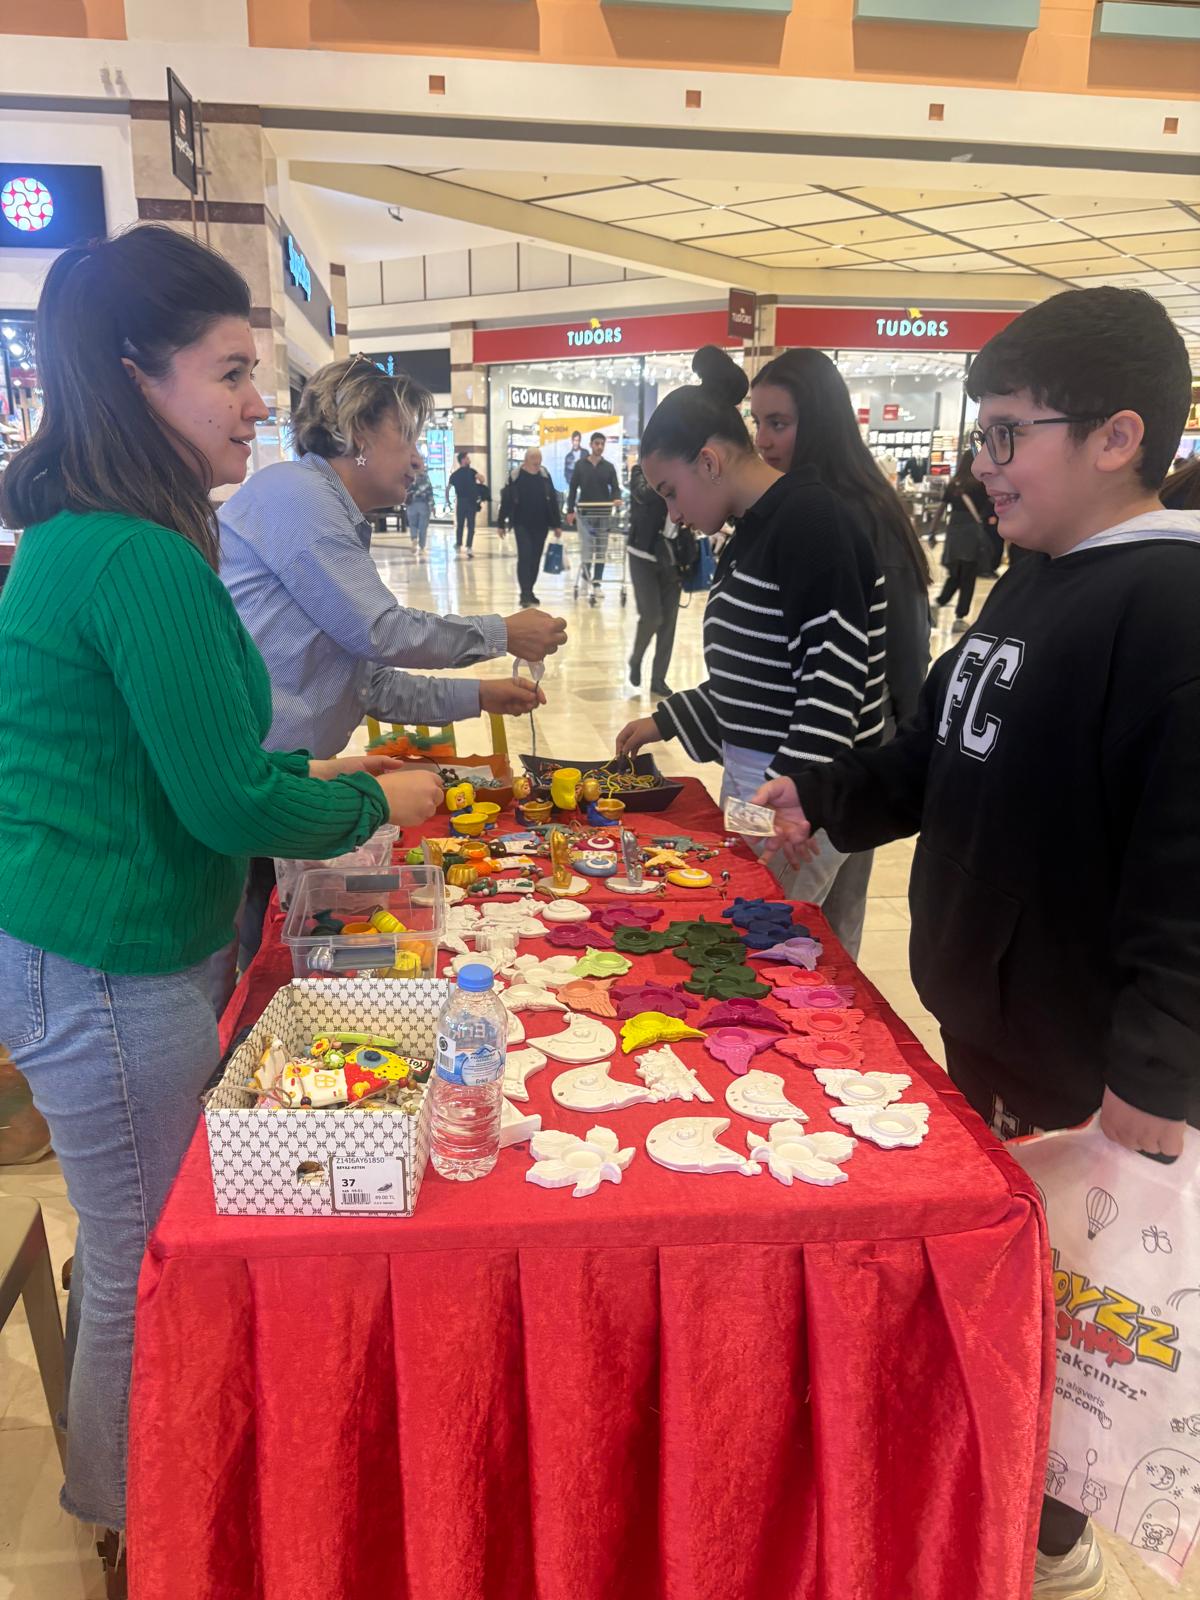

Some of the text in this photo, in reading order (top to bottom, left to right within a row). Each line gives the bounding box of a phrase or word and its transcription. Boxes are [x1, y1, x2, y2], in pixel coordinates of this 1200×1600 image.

[732, 312, 753, 325] TUDORS
[566, 327, 622, 346] TUDORS
[876, 319, 949, 337] TUDORS
[511, 389, 560, 407] GÖMLEK
[936, 633, 1025, 762] FC
[341, 1178, 356, 1187] 37
[1052, 1248, 1181, 1373] OYZZ
[1055, 1386, 1104, 1418] op.com
